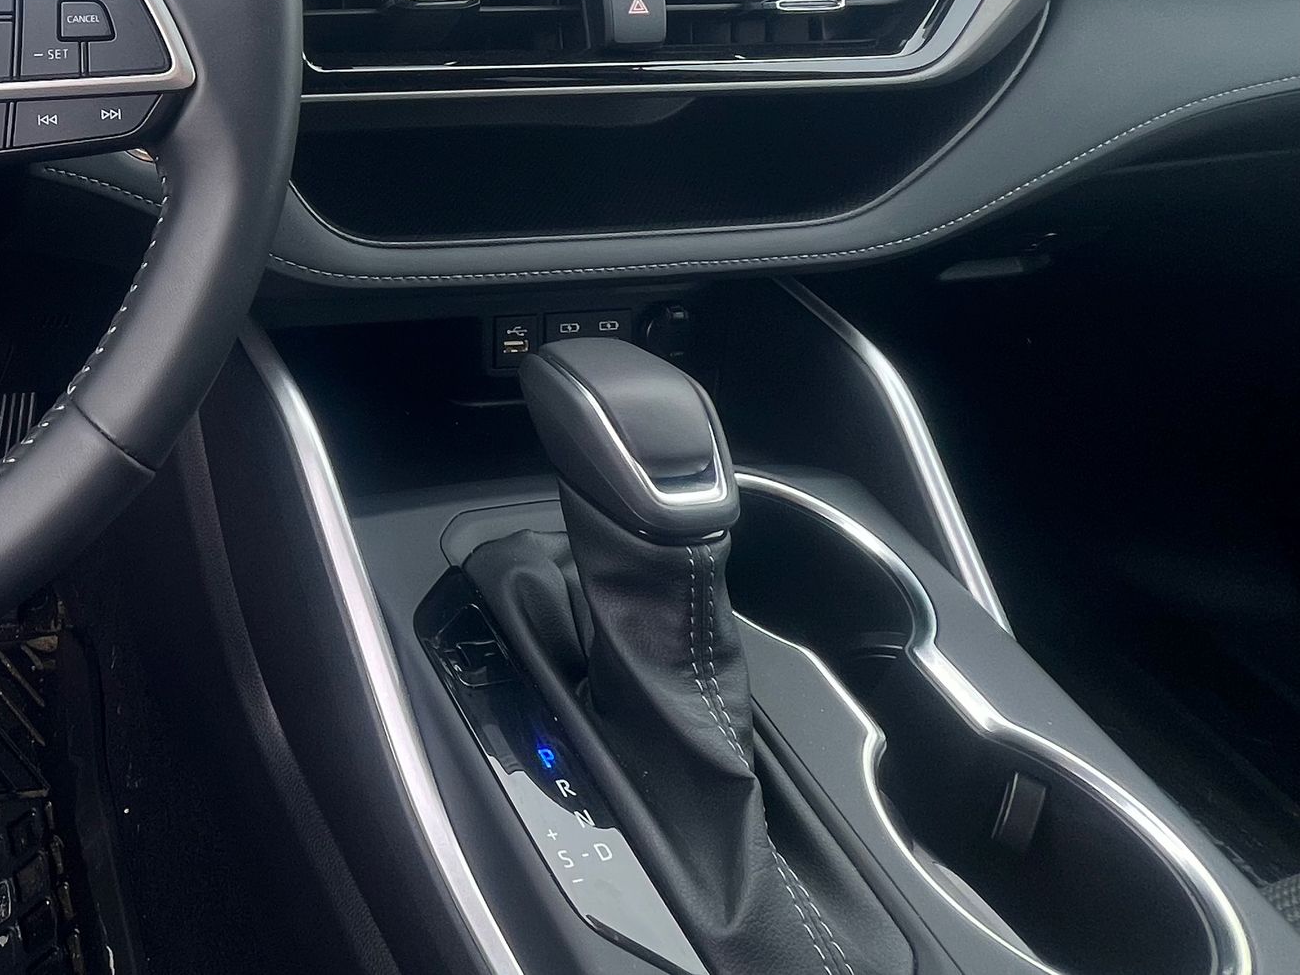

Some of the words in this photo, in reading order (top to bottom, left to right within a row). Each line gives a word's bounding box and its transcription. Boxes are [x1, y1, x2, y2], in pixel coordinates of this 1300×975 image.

[66, 15, 100, 23] CANCEL
[538, 749, 554, 768] P
[556, 779, 577, 797] R
[574, 809, 596, 829] N
[558, 850, 574, 869] S
[594, 843, 613, 861] D
